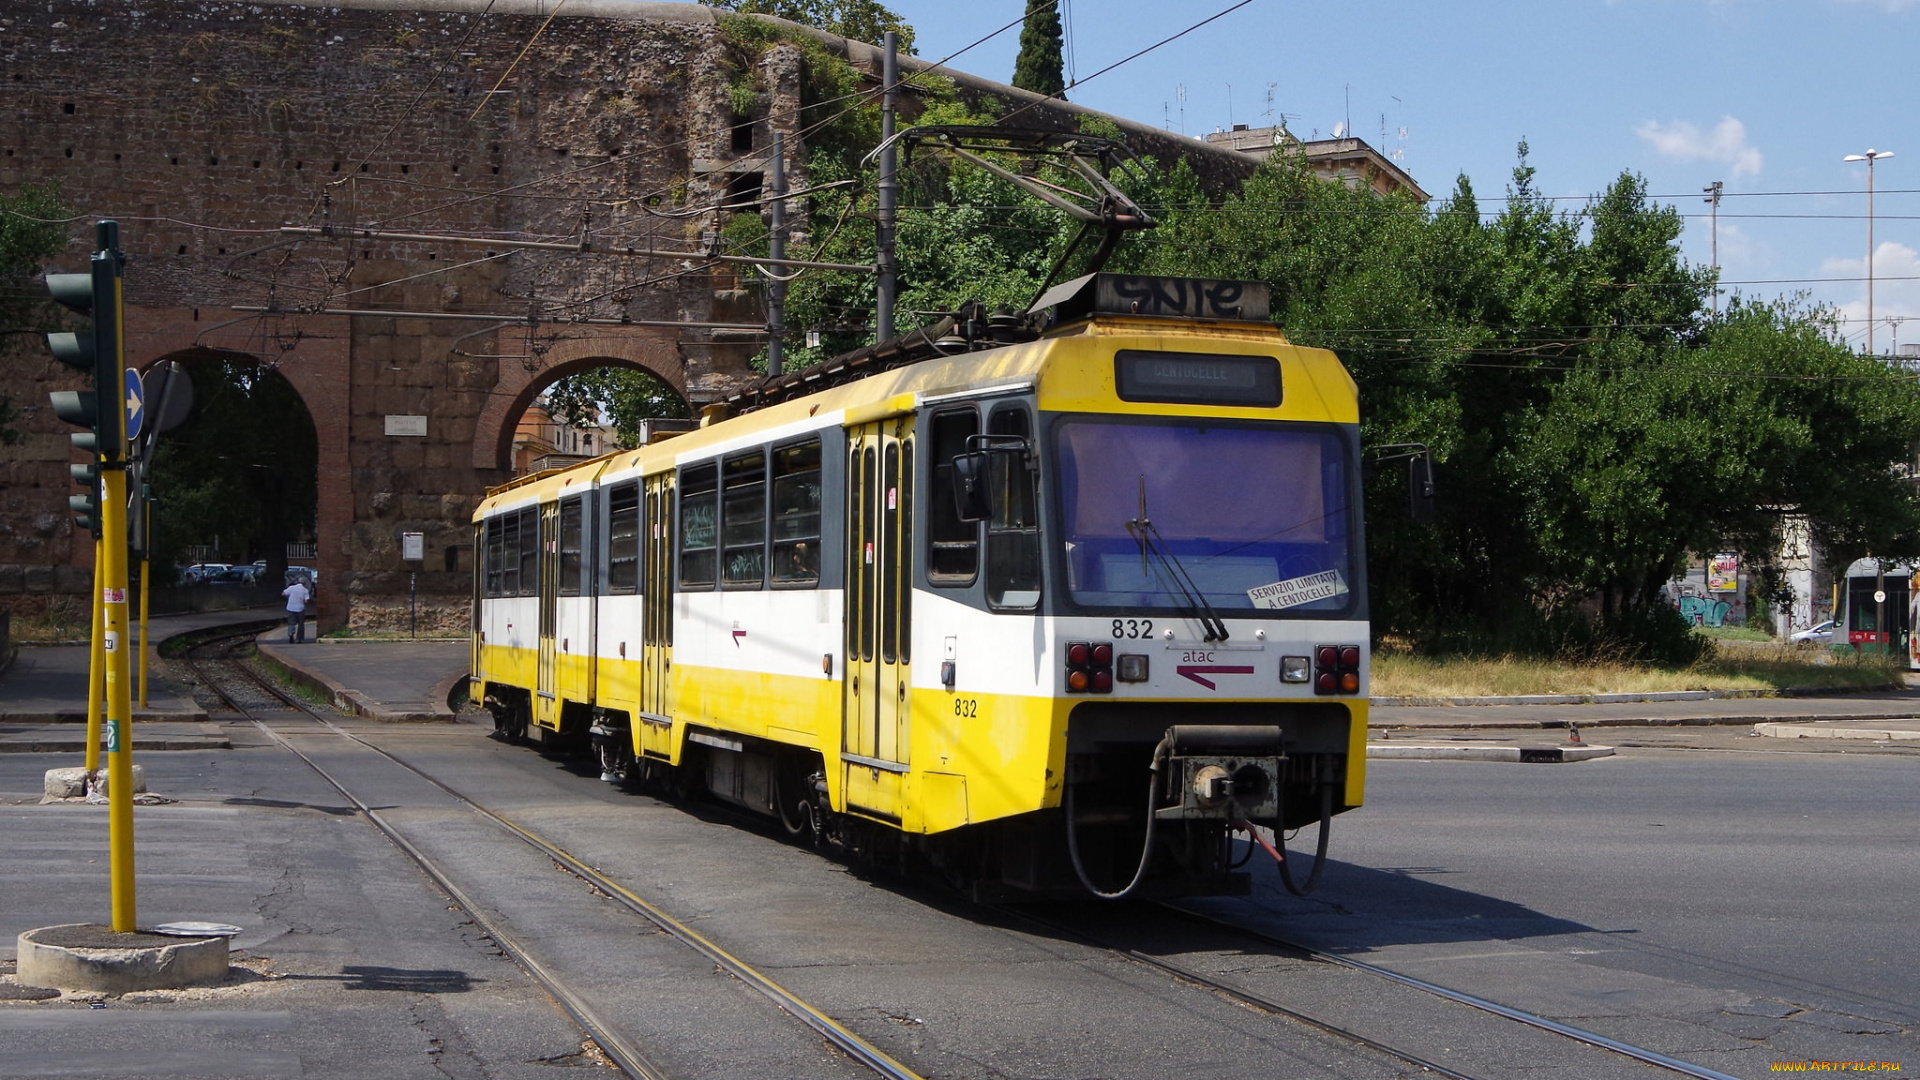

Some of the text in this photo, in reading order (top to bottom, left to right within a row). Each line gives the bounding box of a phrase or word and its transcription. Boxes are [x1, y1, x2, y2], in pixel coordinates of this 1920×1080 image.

[1154, 362, 1227, 380] CENTOCELLE
[1251, 571, 1337, 600] SERVIZIO LIMITATO
[1268, 585, 1333, 609] A CENTOCELLE
[1112, 619, 1154, 639] 832
[1182, 650, 1215, 663] atac
[954, 699, 977, 718] 832
